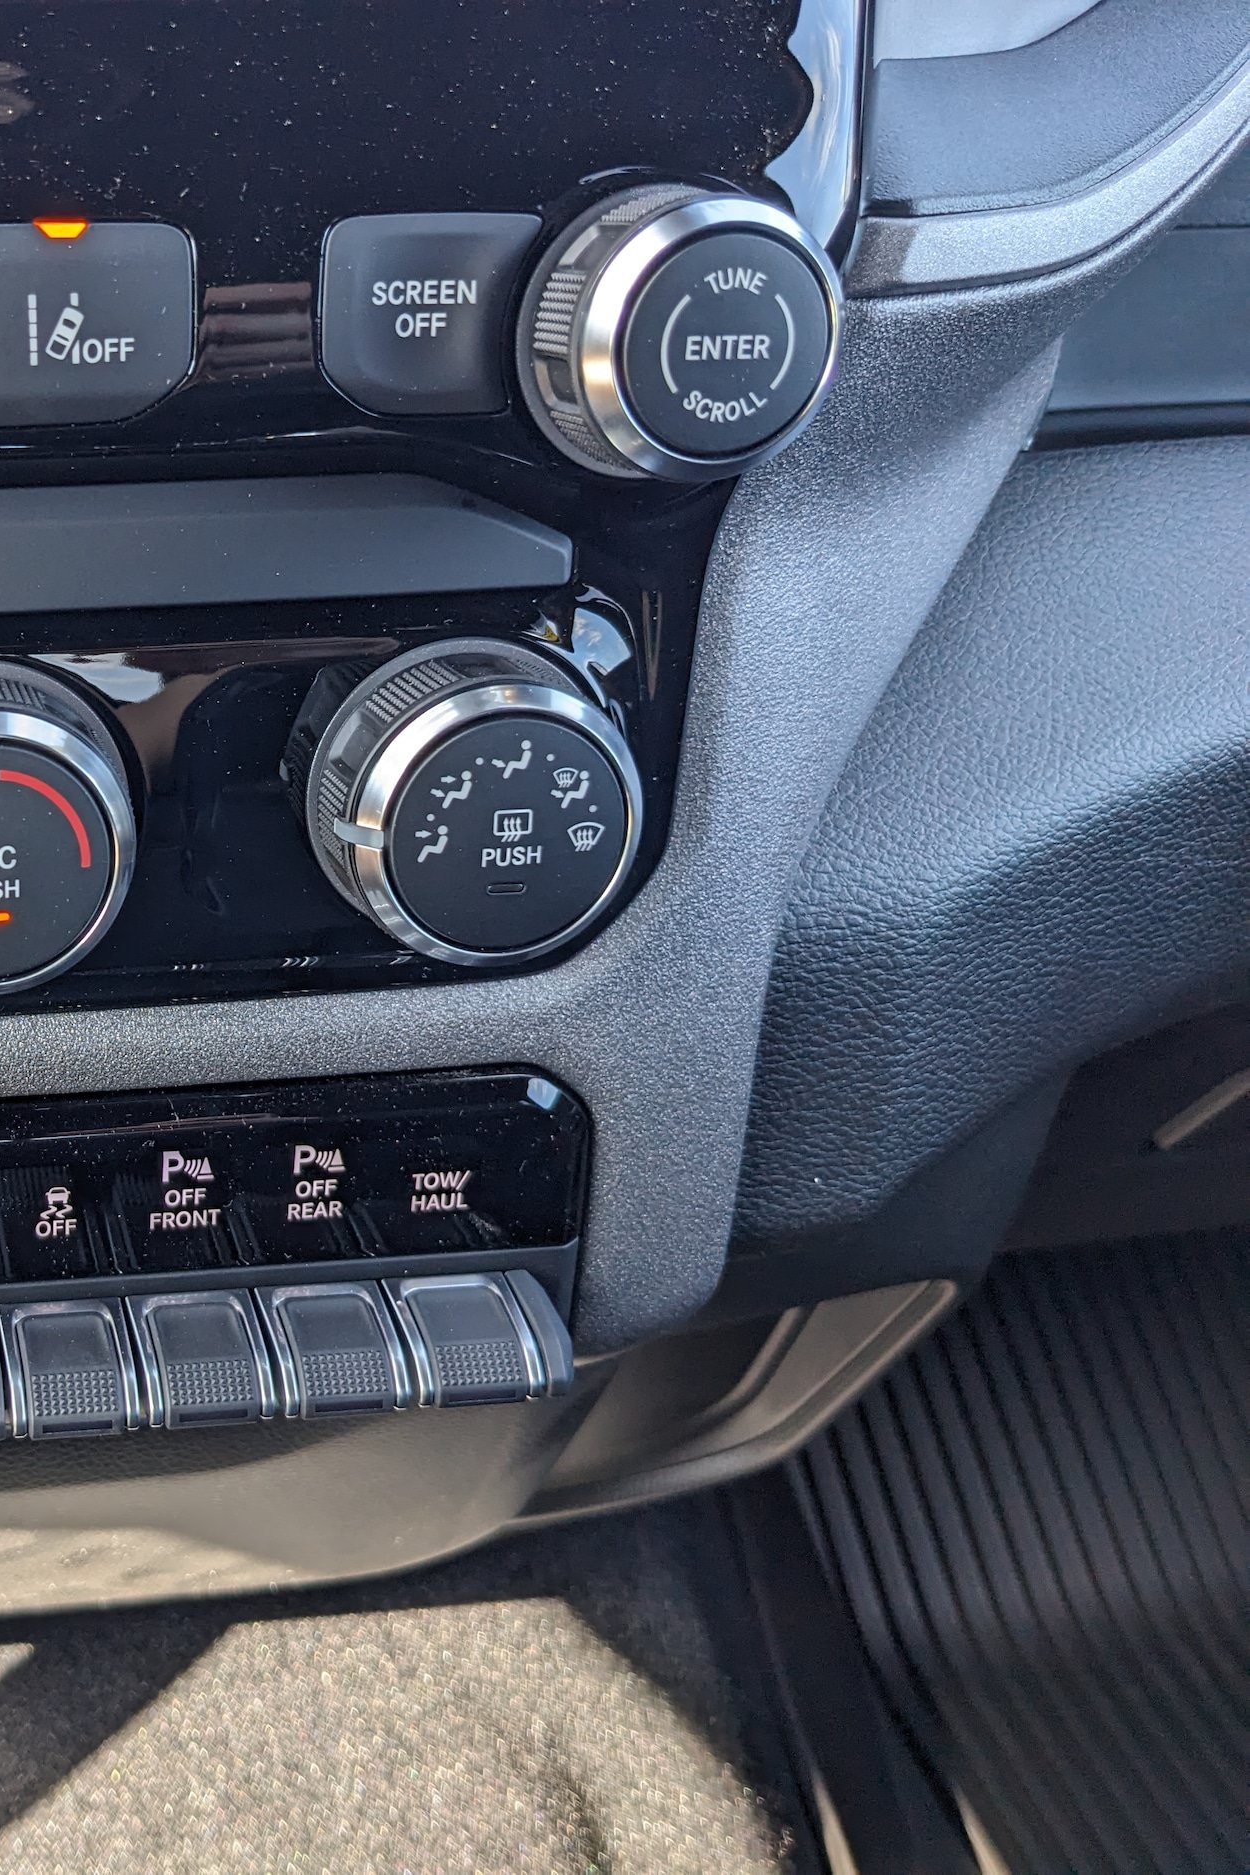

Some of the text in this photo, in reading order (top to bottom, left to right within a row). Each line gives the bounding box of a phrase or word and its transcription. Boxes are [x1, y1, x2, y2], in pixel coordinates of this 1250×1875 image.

[371, 279, 477, 306] SCREEN
[703, 267, 767, 295] TUNE
[395, 312, 447, 338] OFF
[82, 337, 135, 364] OFF
[685, 334, 771, 361] ENTER
[682, 390, 768, 423] SCROLL
[481, 845, 542, 868] PUSH
[164, 1187, 207, 1207] OFF
[295, 1178, 338, 1198] OFF
[287, 1200, 342, 1220] REAR
[410, 1192, 468, 1212] HAUL
[35, 1218, 77, 1238] OFF
[149, 1208, 221, 1230] FRONT
